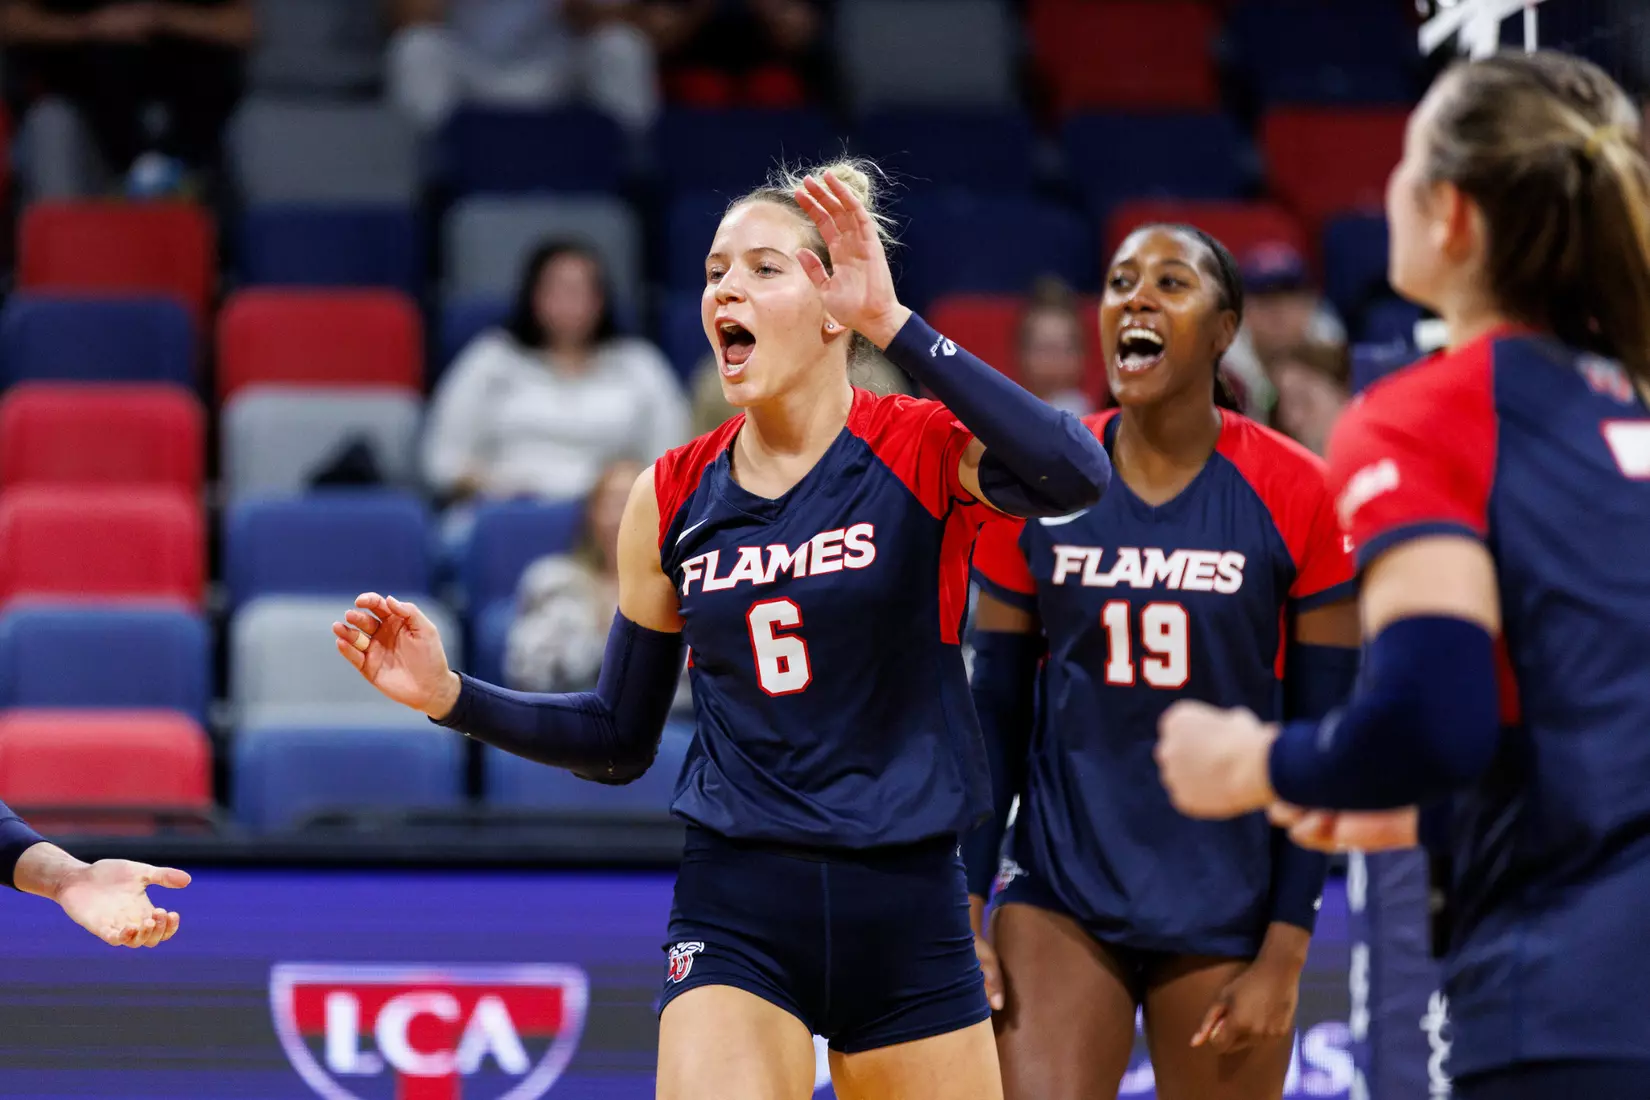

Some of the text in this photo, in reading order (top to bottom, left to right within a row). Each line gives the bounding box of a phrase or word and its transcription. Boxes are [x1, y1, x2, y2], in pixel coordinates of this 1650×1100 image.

[680, 522, 876, 596] FLAMES
[1052, 545, 1246, 594] FLAMES
[745, 596, 813, 697] 6
[1101, 600, 1191, 690] 19
[324, 990, 531, 1077] LCA
